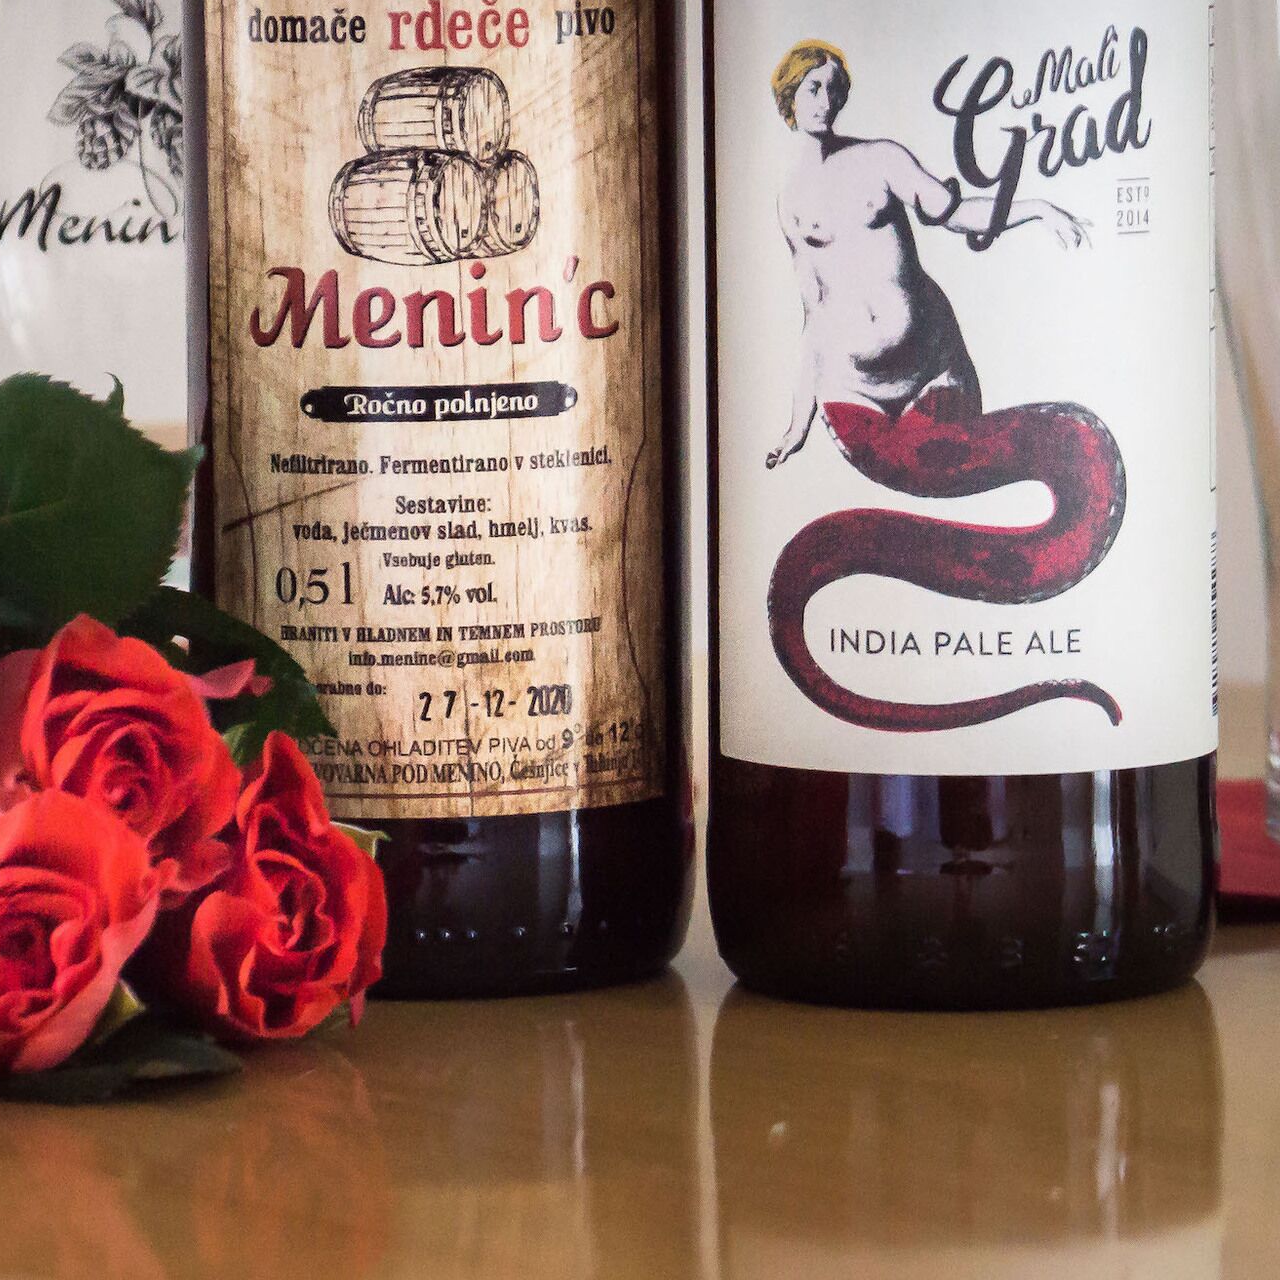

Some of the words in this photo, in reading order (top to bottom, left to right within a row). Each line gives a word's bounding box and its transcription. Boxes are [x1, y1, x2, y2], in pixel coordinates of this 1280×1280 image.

[249, 8, 366, 43] domače
[555, 1, 615, 45] pivo
[1011, 24, 1120, 109] Mali
[933, 26, 1152, 252] Grad
[1116, 209, 1149, 228] 2014
[343, 391, 426, 416] Ročno
[434, 390, 538, 420] polnjeno
[380, 455, 508, 475] Fermentirano
[515, 456, 524, 471] v
[395, 495, 491, 515] Sestavine:
[293, 521, 338, 543] voda,
[341, 520, 431, 545] ječmenov
[437, 520, 482, 541] slad,
[489, 518, 544, 540] hmelj,
[550, 515, 593, 535] kvas.
[383, 552, 441, 570] Vsebuje
[445, 550, 496, 570] gluten.
[465, 581, 498, 604] vol.
[281, 625, 338, 642] HRANITI
[342, 627, 351, 642] V
[356, 626, 431, 643] HLADNEM
[436, 626, 453, 642] IN
[458, 623, 525, 642] TEMNEM
[531, 616, 601, 638] PROSTORU
[830, 628, 921, 655] INDIA
[934, 631, 1013, 656] PALE
[1025, 629, 1083, 654] ALE
[366, 681, 387, 696] do:
[527, 683, 573, 717] 2020
[368, 737, 482, 758] OHLADITEV
[489, 733, 532, 754] PIVA
[536, 734, 556, 751] od
[392, 763, 428, 784] POD
